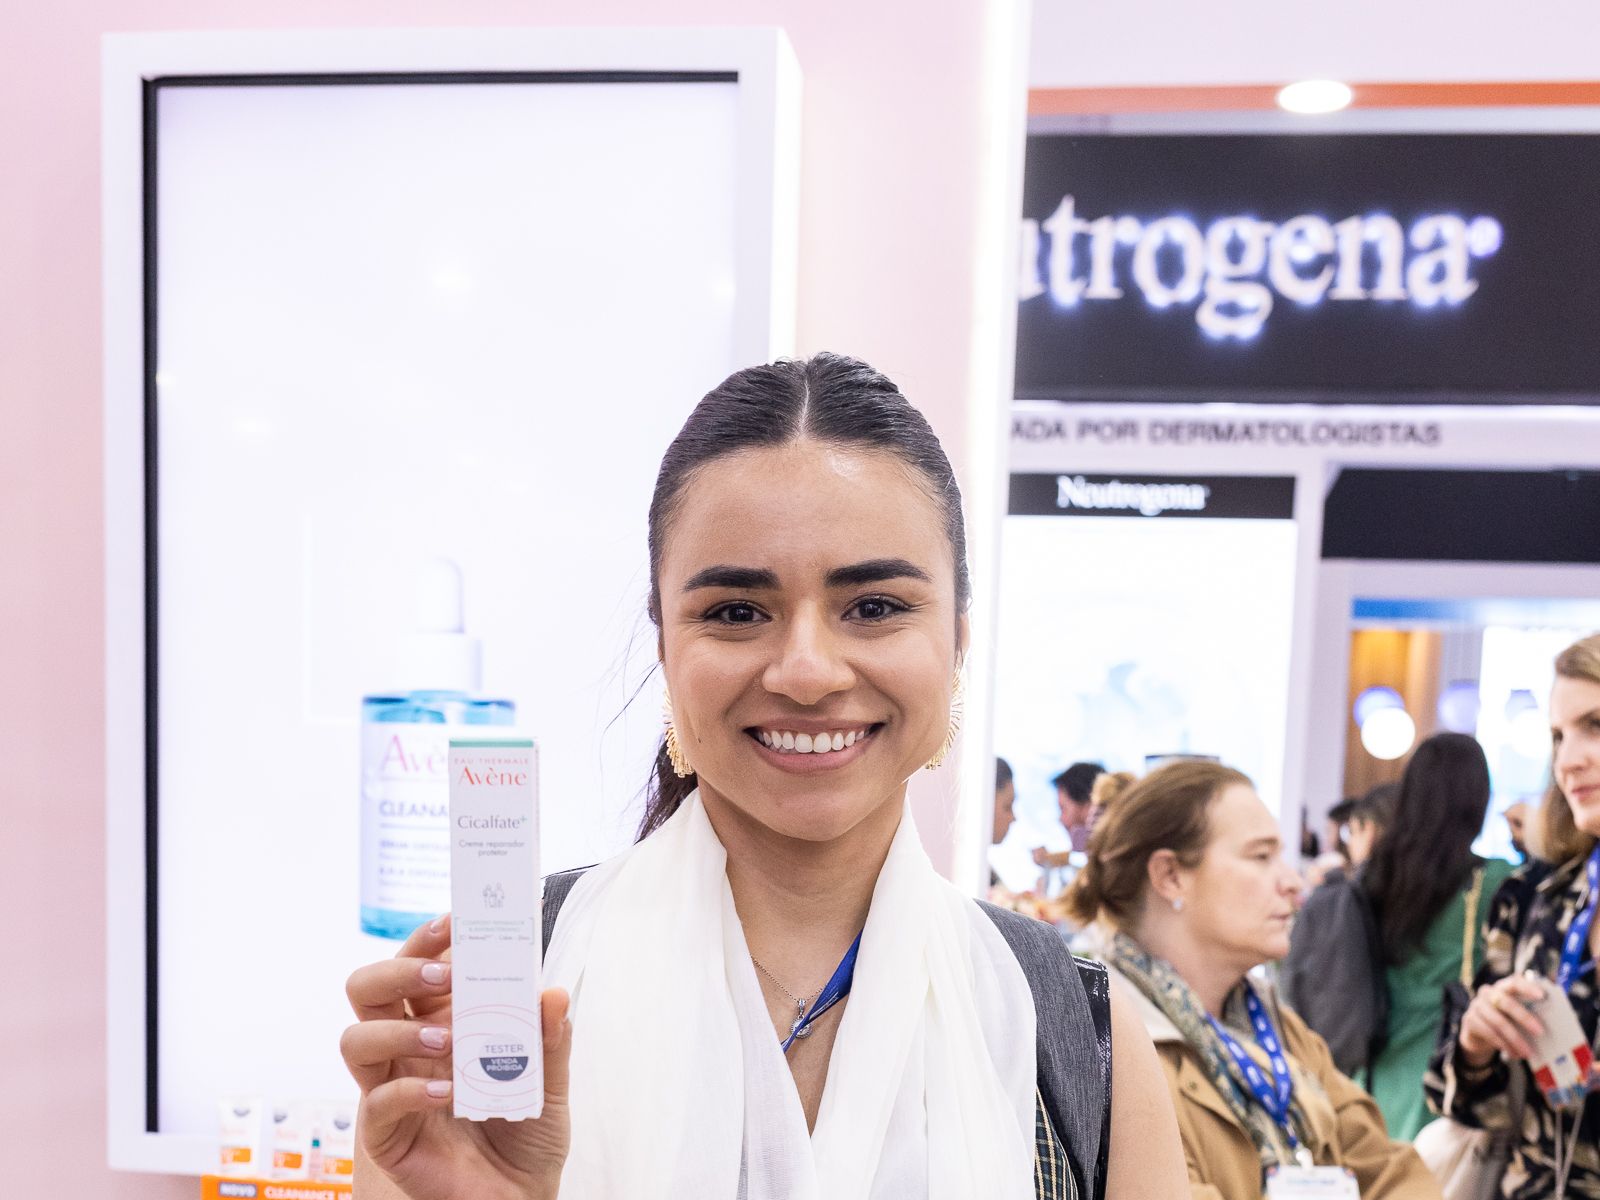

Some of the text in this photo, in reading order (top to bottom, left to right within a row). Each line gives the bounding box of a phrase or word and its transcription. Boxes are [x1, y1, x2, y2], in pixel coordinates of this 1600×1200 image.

[1076, 420, 1140, 444] POR
[458, 766, 528, 786] Avène
[485, 1044, 525, 1054] TESTER
